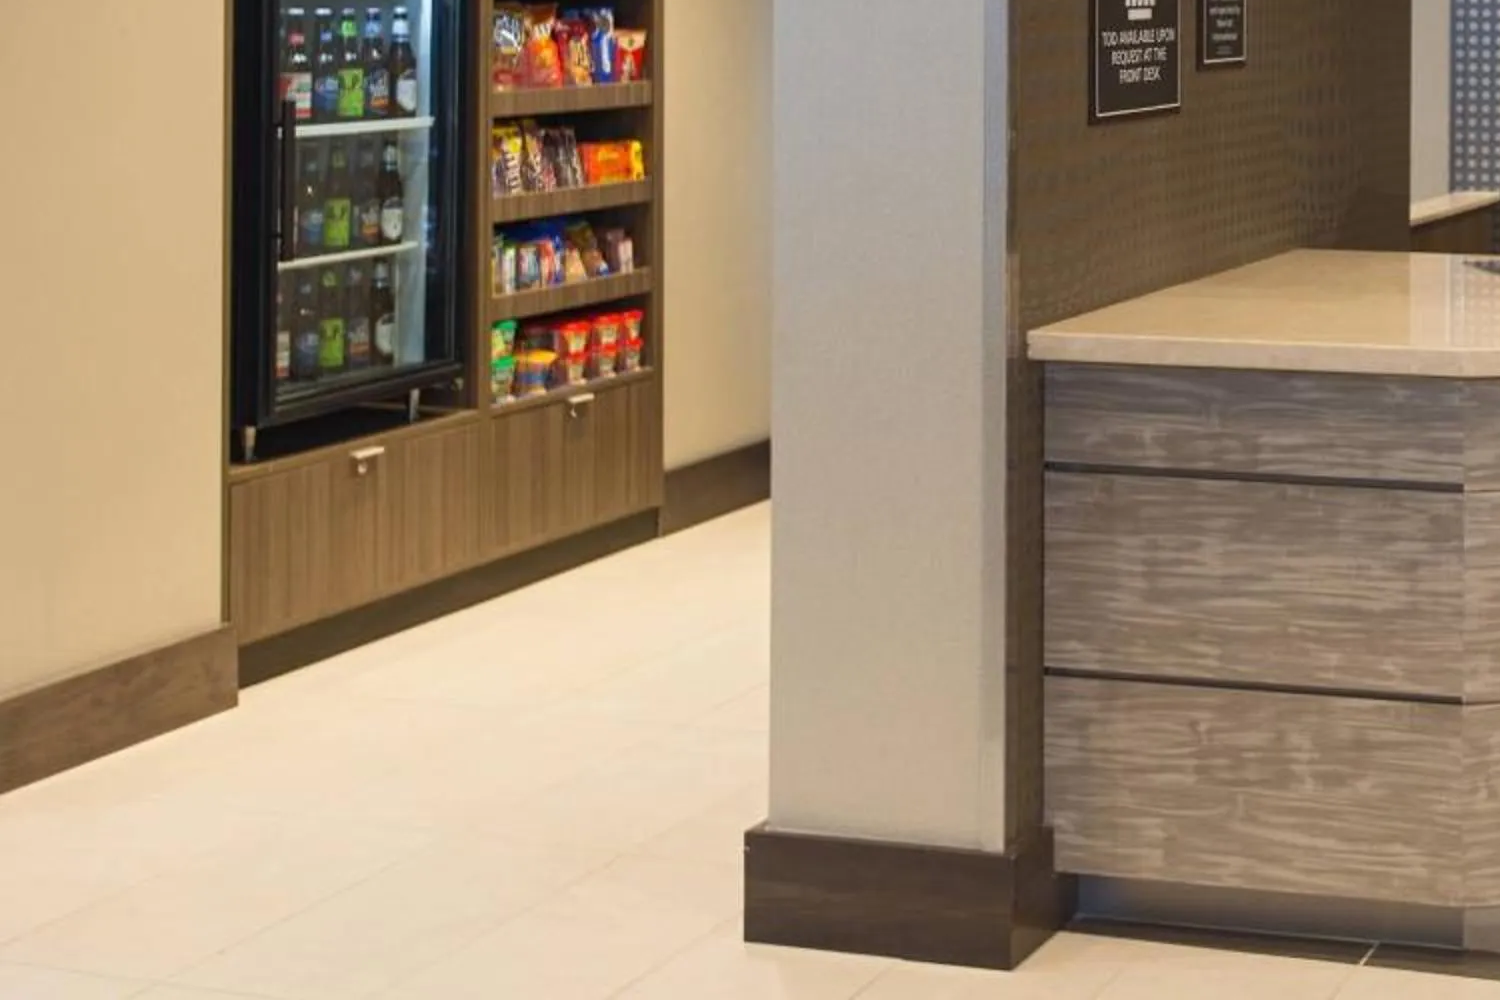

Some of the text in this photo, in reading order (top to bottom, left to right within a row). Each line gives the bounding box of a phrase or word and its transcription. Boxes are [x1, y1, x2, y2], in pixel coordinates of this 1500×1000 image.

[1119, 28, 1155, 45] AVAILABLE
[1156, 27, 1175, 42] UPON
[1111, 46, 1167, 65] REQUEST AT THE
[1119, 65, 1162, 84] FRONT DESK
